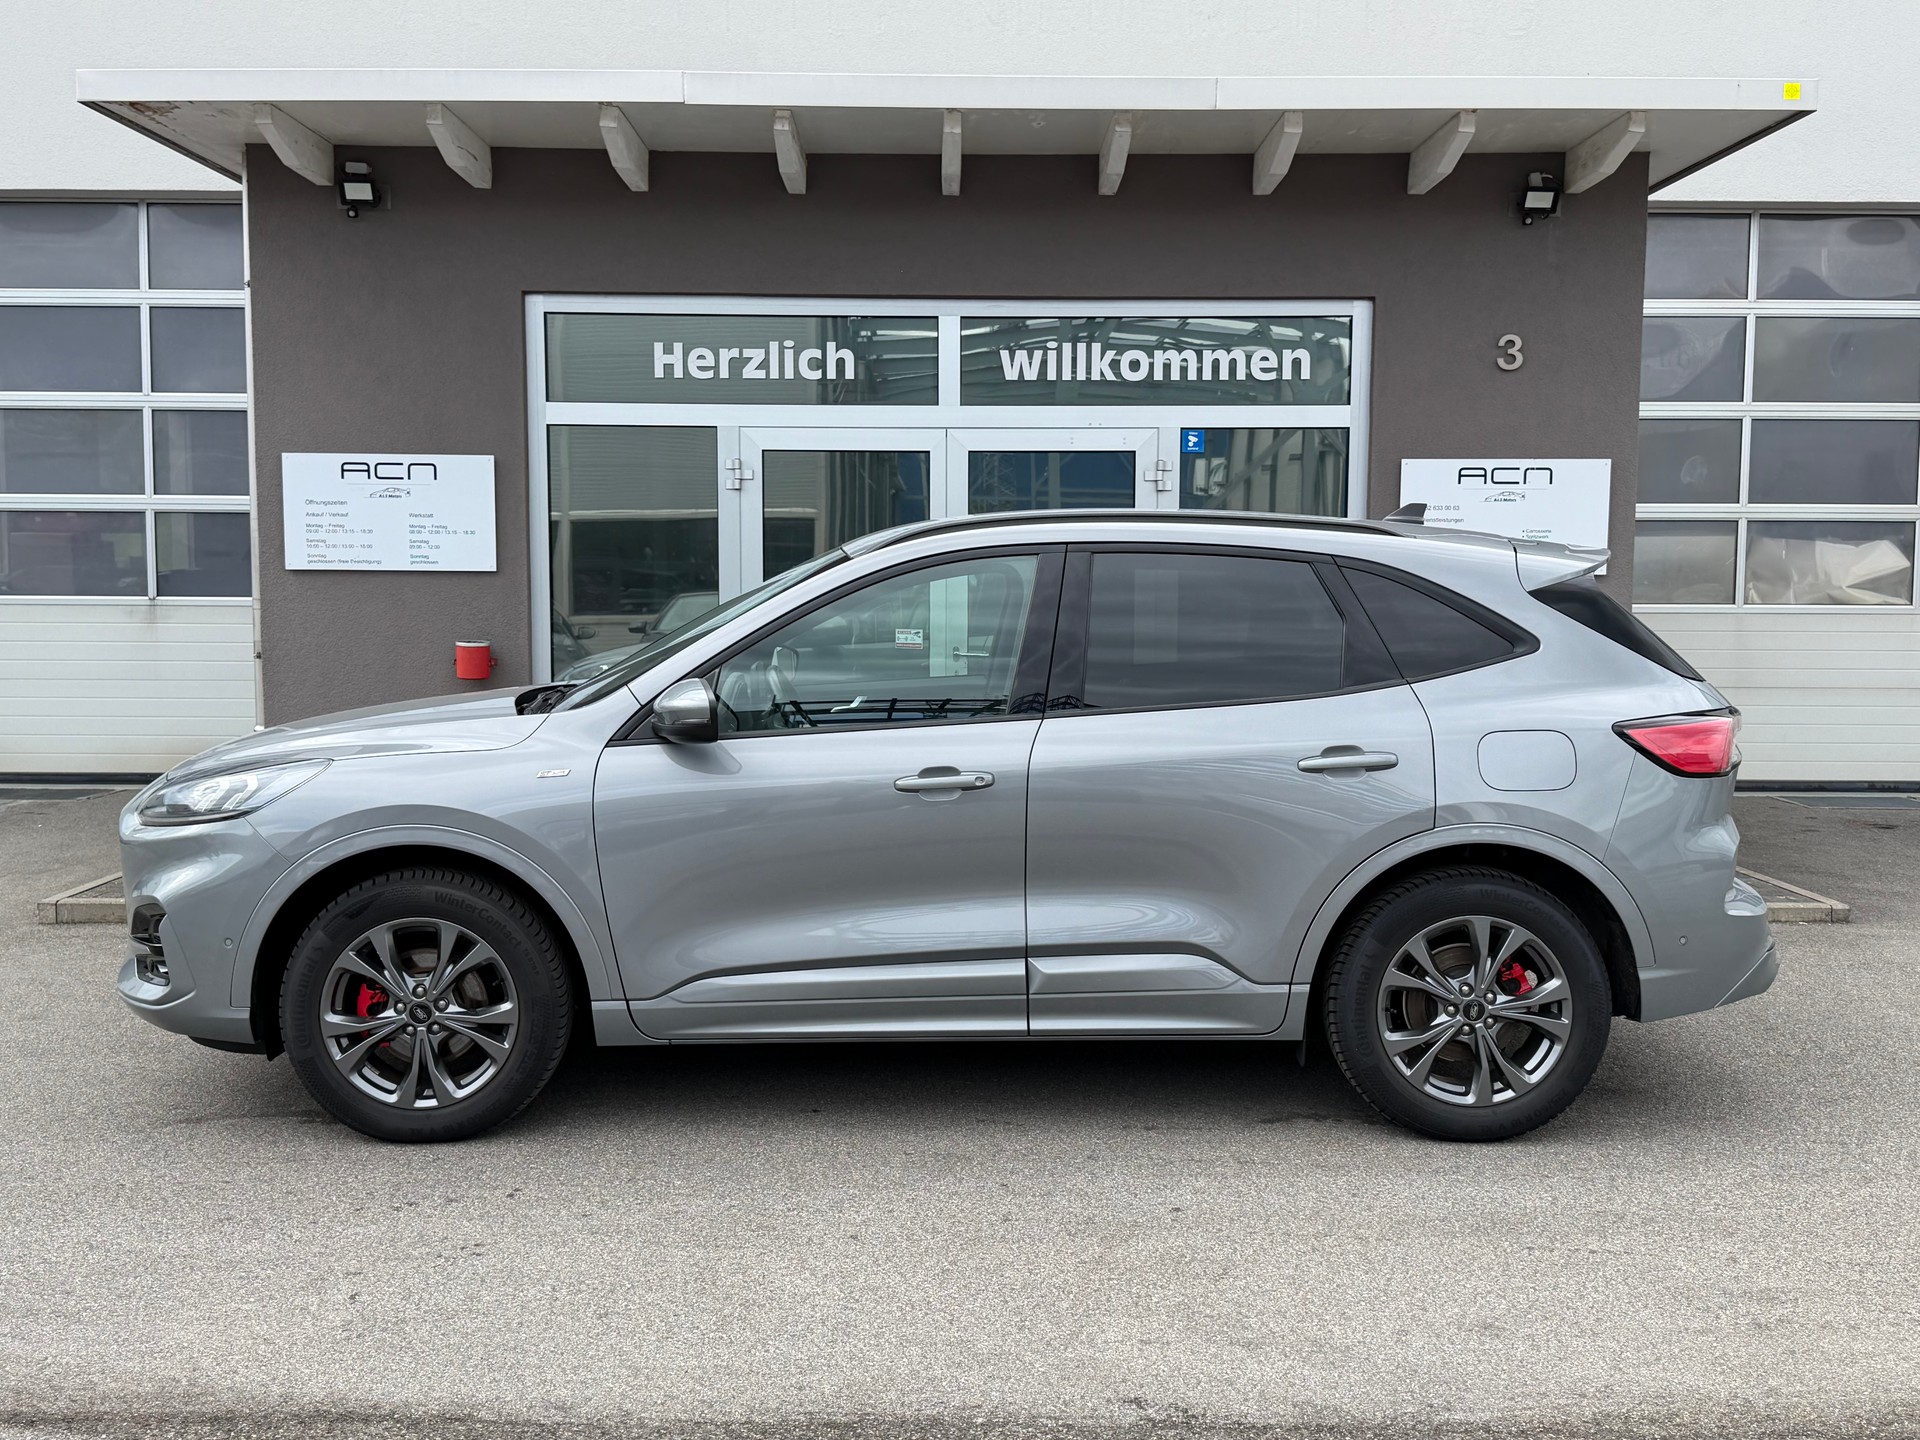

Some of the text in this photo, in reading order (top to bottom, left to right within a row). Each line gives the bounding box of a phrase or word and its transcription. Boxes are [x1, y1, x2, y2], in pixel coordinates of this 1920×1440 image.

[653, 340, 1311, 381] Herzlich willkommen
[1496, 334, 1523, 370] 3
[305, 498, 348, 506] Öffnungszeiten
[434, 891, 522, 948] WinterContact
[1352, 963, 1374, 1057] Continental
